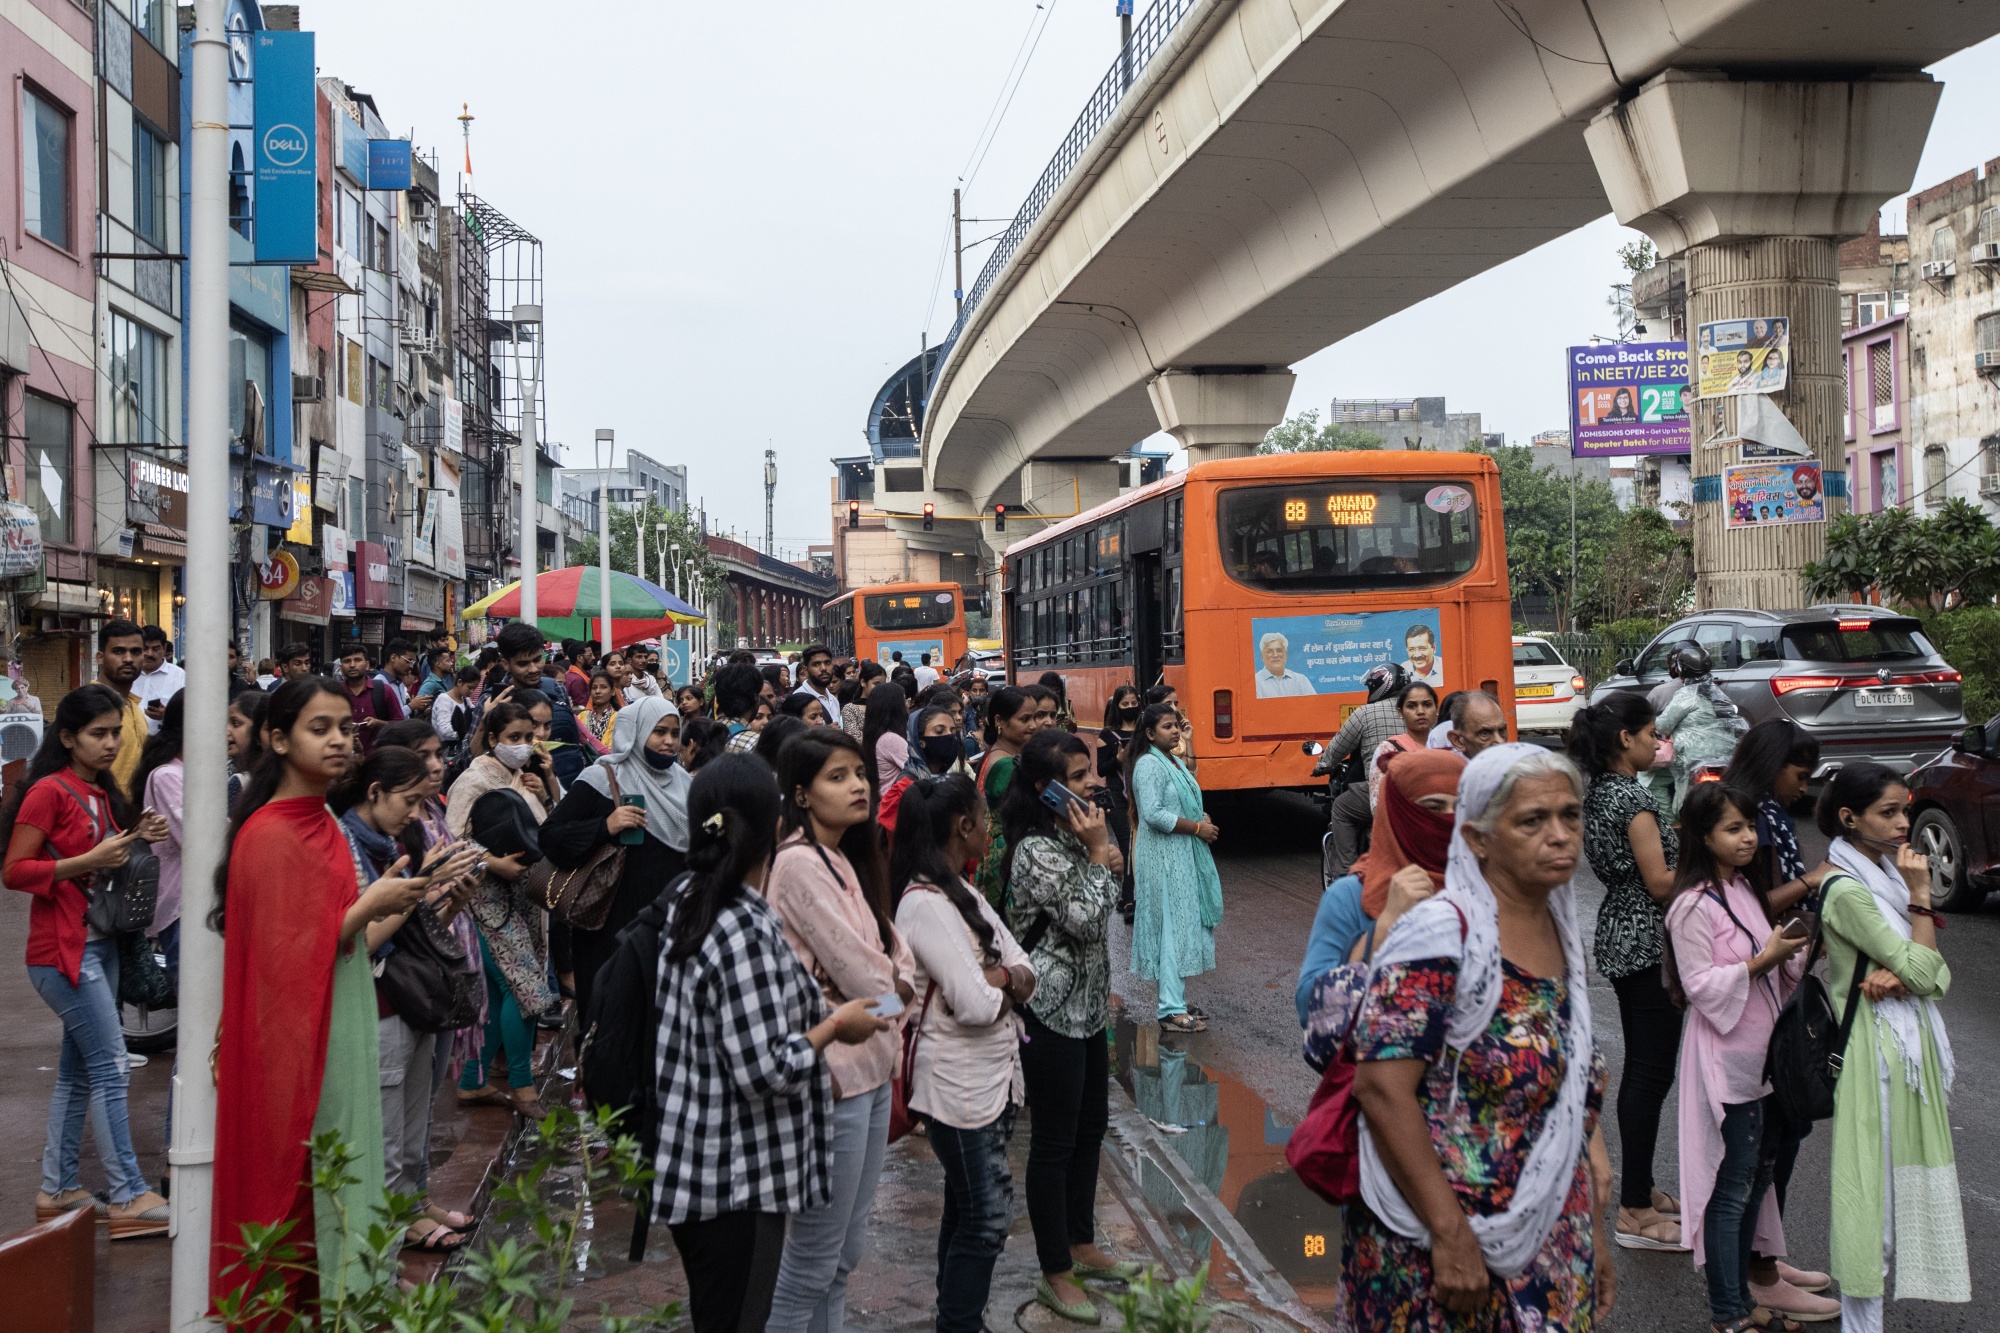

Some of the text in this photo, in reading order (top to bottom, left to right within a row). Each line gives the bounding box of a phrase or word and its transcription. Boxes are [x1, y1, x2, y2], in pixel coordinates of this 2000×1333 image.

[269, 139, 303, 151] DELL
[1575, 349, 1688, 364] Come Back Stro
[1578, 364, 1689, 381] in NEET/JEE 20
[1582, 392, 1595, 424] 1
[1643, 389, 1662, 421] 2
[1579, 430, 1624, 438] ADMISSIONS
[1662, 428, 1670, 436] Up
[1584, 437, 1691, 449] Repeater Batch for NEET/J
[141, 460, 172, 489] FINGER
[1328, 496, 1376, 511] ANAND
[1285, 502, 1306, 521] 88
[1331, 512, 1373, 525] VIHAR
[1311, 643, 1323, 652] लेन
[1333, 640, 1358, 653] ड्राइविंग
[1372, 641, 1384, 649] रहा
[1326, 657, 1337, 665] बस
[1339, 655, 1351, 664] लेन
[1352, 653, 1362, 663] को
[1364, 653, 1373, 664] फ्री
[1861, 692, 1912, 704] DL14CE7159
